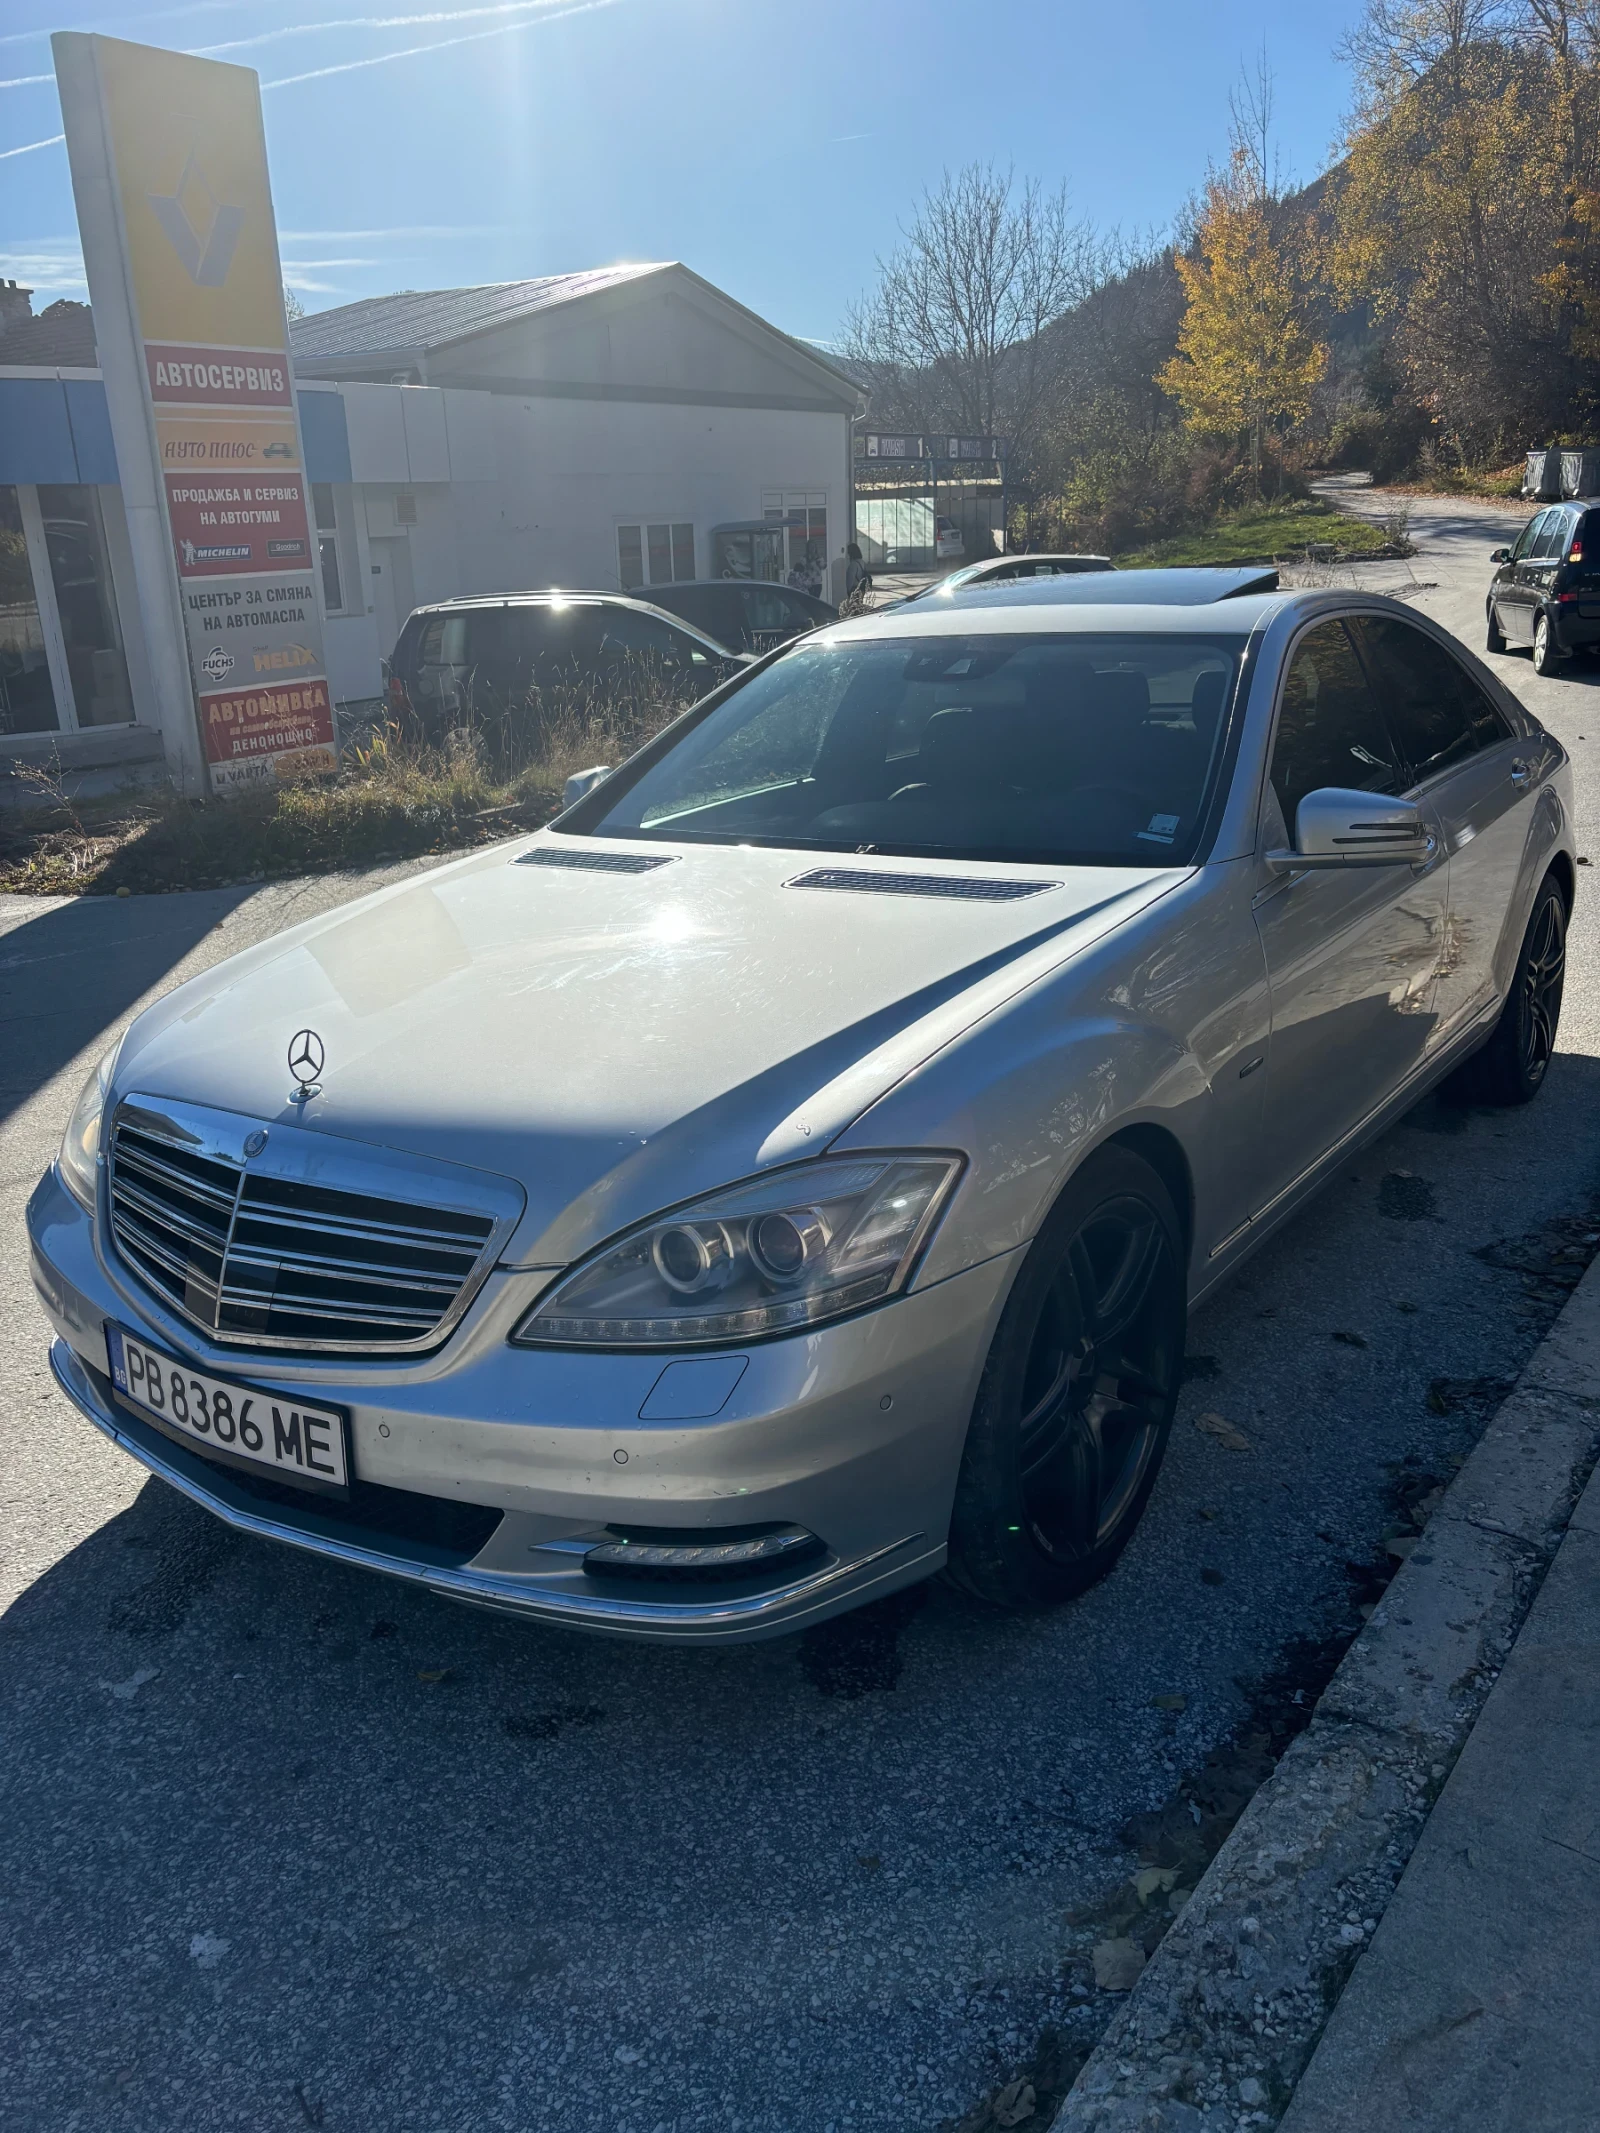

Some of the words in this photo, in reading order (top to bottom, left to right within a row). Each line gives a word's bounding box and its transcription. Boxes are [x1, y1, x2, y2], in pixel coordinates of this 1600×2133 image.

[156, 361, 284, 392] АВТОСЕРВИЗ
[164, 441, 206, 459] АУТО
[209, 442, 256, 459] ПЛЮС
[917, 437, 923, 458] 1
[991, 439, 997, 459] 2
[172, 488, 240, 504] ПРОДАЖБА
[243, 488, 252, 502] И
[255, 487, 299, 501] СЕРВИЗ
[200, 511, 217, 525] НА
[220, 510, 281, 525] АВТОГУМИ
[197, 547, 249, 558] MICHELIN
[189, 591, 242, 611] ЦЕНТЪР
[245, 590, 263, 604] ЗА
[266, 585, 313, 602] СМЯНА
[203, 616, 222, 631] НА
[226, 608, 305, 629] АВТОМАСЛА
[202, 657, 234, 670] FUCHS
[252, 648, 317, 672] HELIX
[208, 688, 326, 724] АВТОМИВКА
[232, 728, 313, 755] ДЕНОНОЩНО
[113, 1366, 127, 1386] BG
[126, 1343, 165, 1410] PB
[170, 1371, 264, 1452] 8386
[271, 1405, 335, 1475] ME
